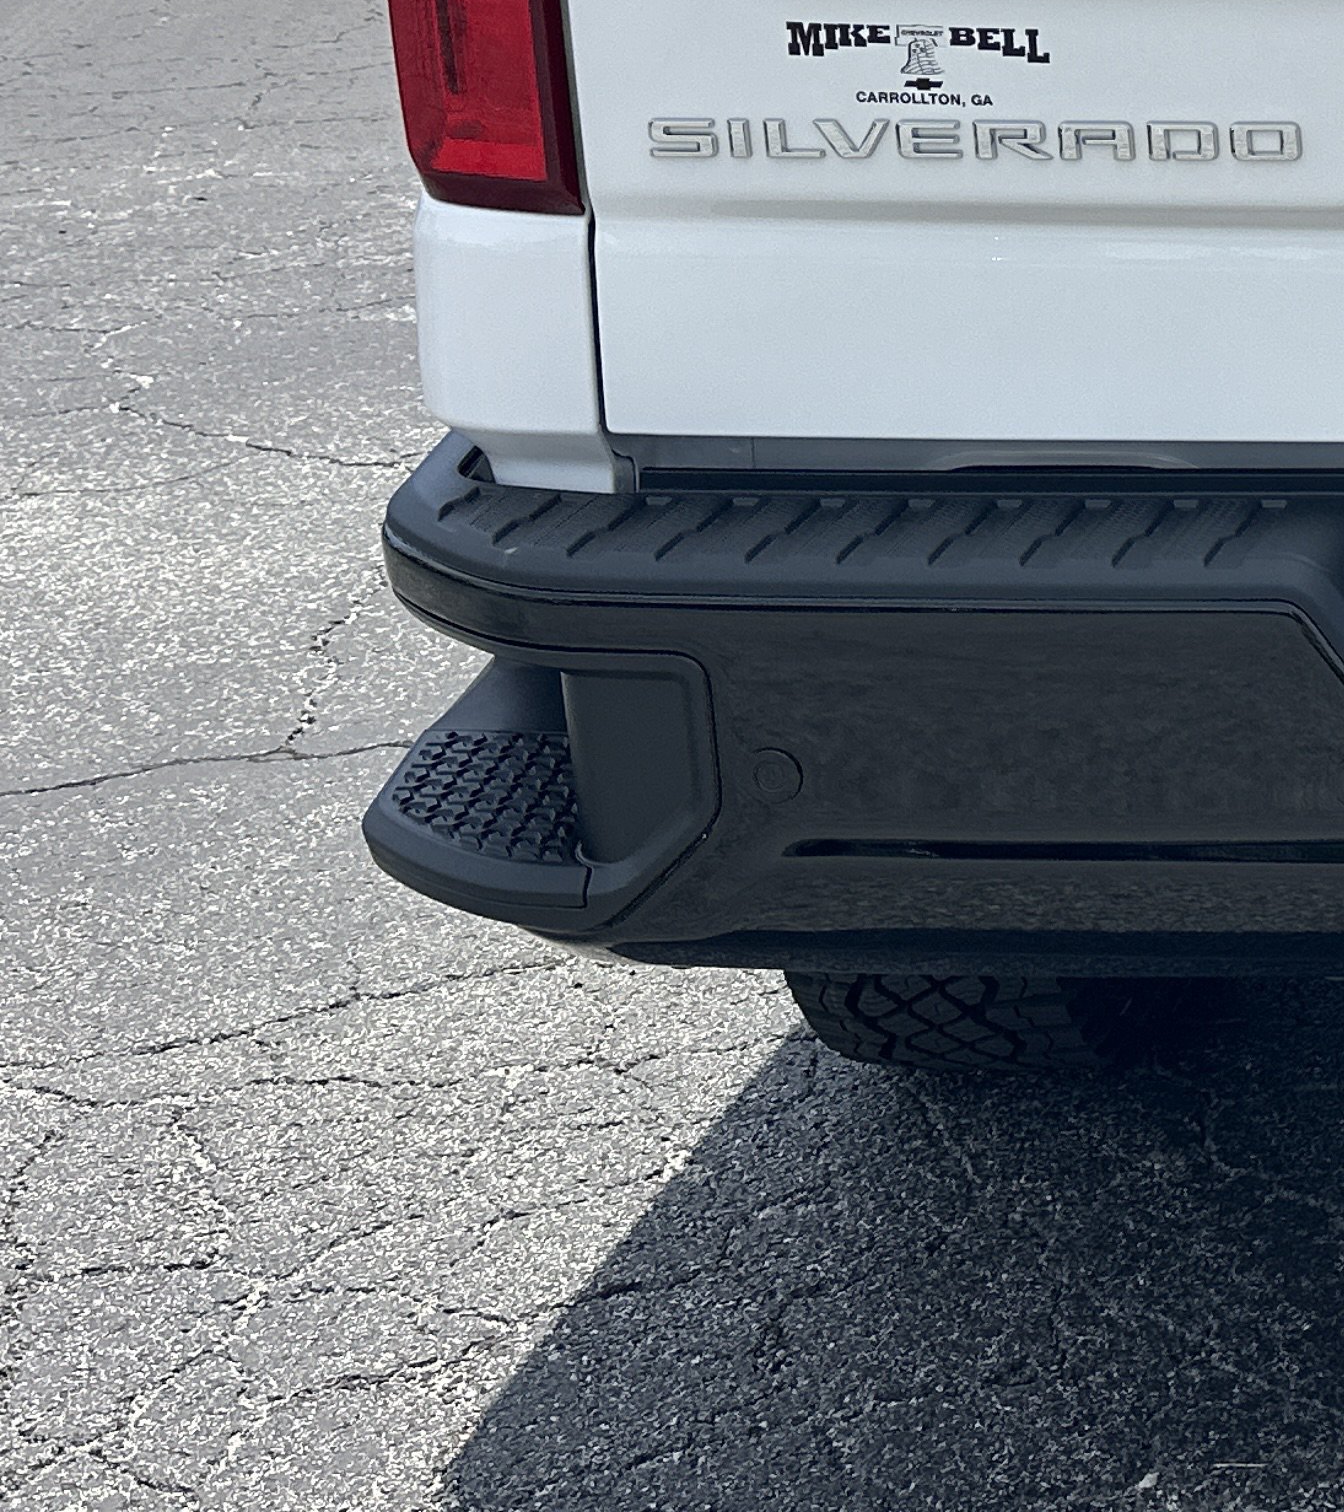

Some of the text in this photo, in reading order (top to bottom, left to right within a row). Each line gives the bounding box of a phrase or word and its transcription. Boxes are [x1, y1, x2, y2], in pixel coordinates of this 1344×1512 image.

[786, 21, 1050, 63] MIKE BELL
[856, 91, 993, 108] CARROLLTON, GA
[649, 117, 1302, 161] SILVERADO
